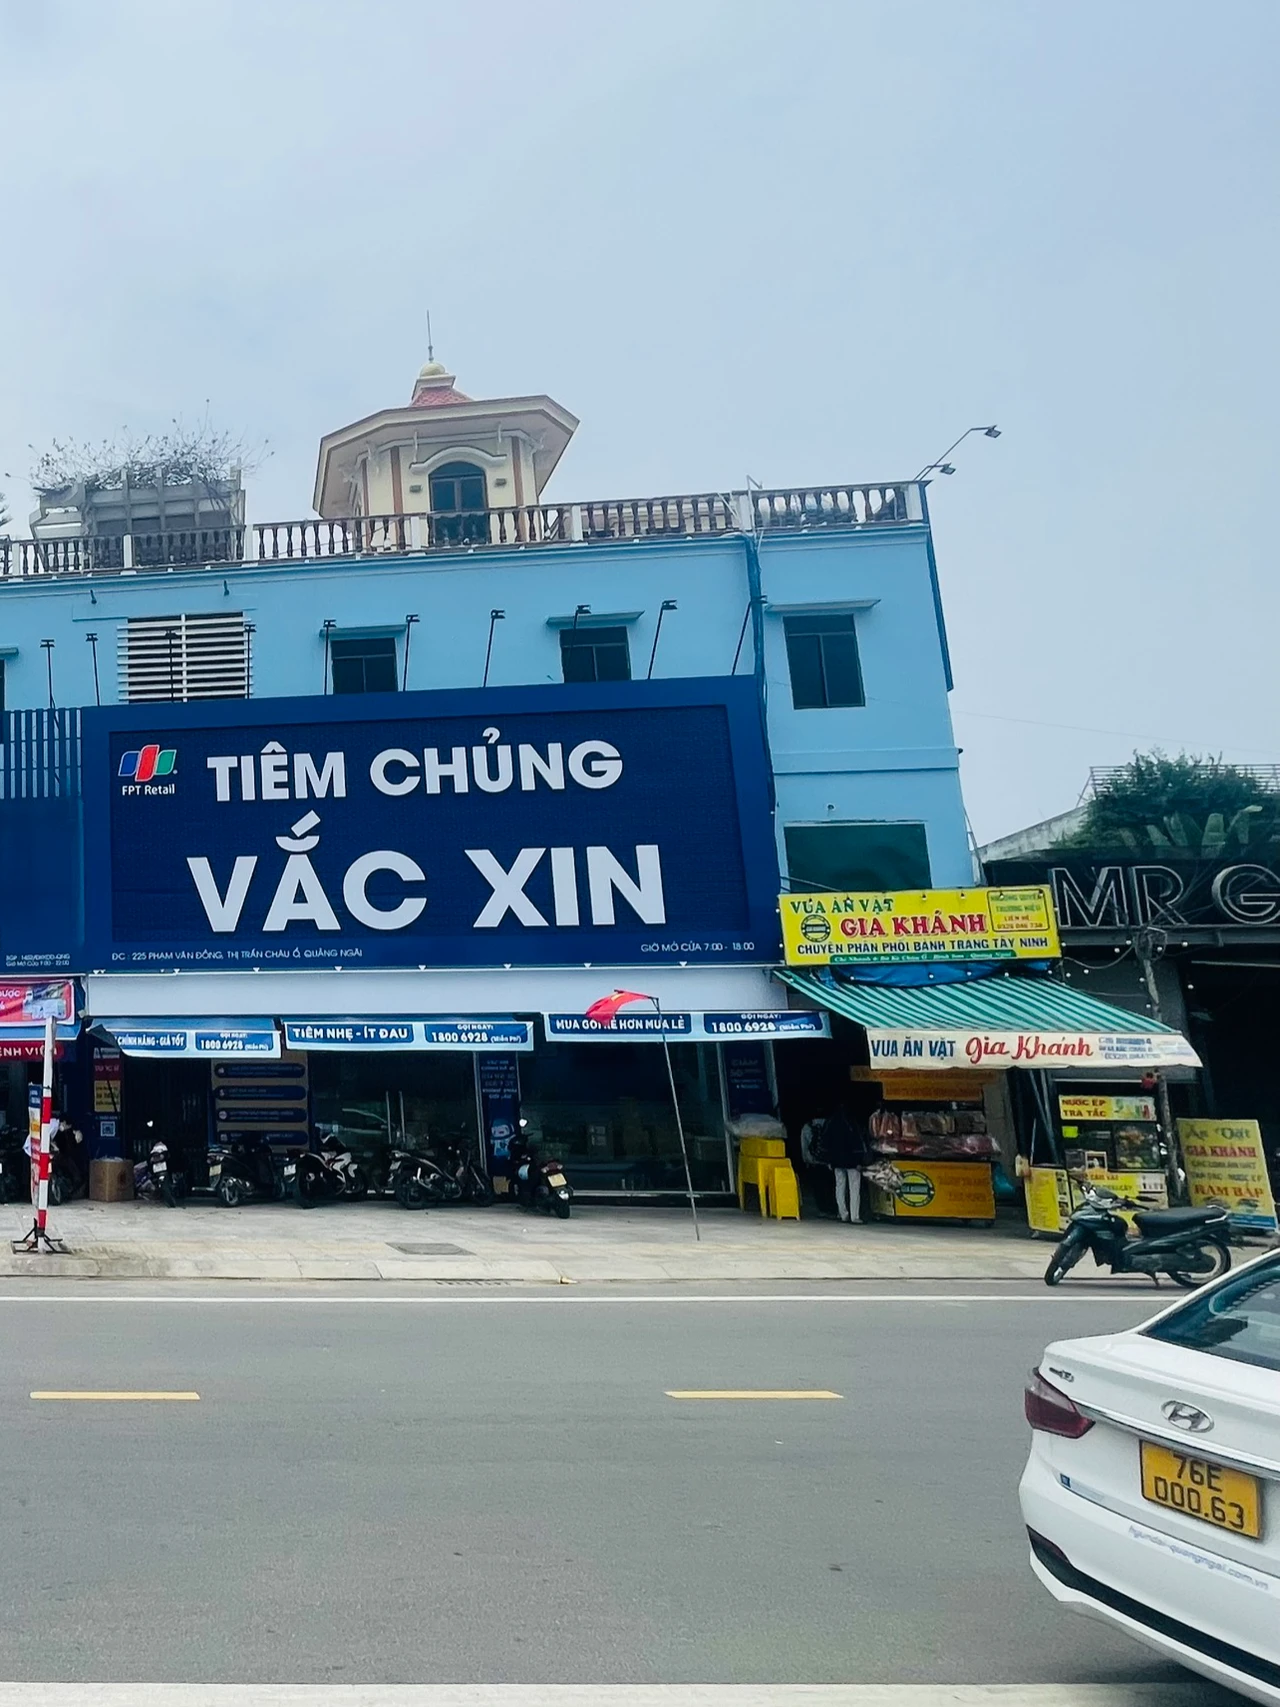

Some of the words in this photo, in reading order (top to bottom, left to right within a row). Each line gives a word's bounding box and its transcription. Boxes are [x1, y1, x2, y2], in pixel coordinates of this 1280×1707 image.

[207, 741, 346, 801] TIÊM
[369, 727, 623, 796] CHỦNG
[122, 785, 141, 796] FPT
[144, 784, 175, 795] Retail
[186, 809, 427, 933] VẮC
[464, 845, 666, 930] XIN
[1051, 865, 1187, 928] MR
[790, 899, 826, 915] VUA
[840, 917, 889, 937] GIA
[892, 910, 989, 937] KHÁNH
[132, 952, 147, 960] 225
[797, 942, 843, 955] CHUYÊN
[1020, 938, 1048, 948] NINH
[556, 1020, 580, 1030] MUA
[620, 1019, 643, 1030] HƠN
[645, 1020, 670, 1030] MUA
[671, 1015, 685, 1029] LẺ
[712, 1022, 742, 1033] 1800
[744, 1021, 776, 1033] 6928
[292, 1023, 324, 1040] TIÊM
[327, 1027, 353, 1043] NHẸ
[363, 1022, 377, 1040] ÍT
[379, 1027, 408, 1040] ĐAU
[431, 1032, 459, 1043] 1800
[461, 1032, 488, 1043] 6928
[200, 1039, 220, 1050] 1800
[221, 1039, 243, 1050] 6928
[871, 1040, 898, 1057] VUA
[903, 1035, 923, 1057] ĂN
[928, 1036, 956, 1061] VẶT
[1011, 1035, 1094, 1060] Khánh
[1173, 1453, 1223, 1493] 76E
[1154, 1476, 1246, 1530] 000.63
